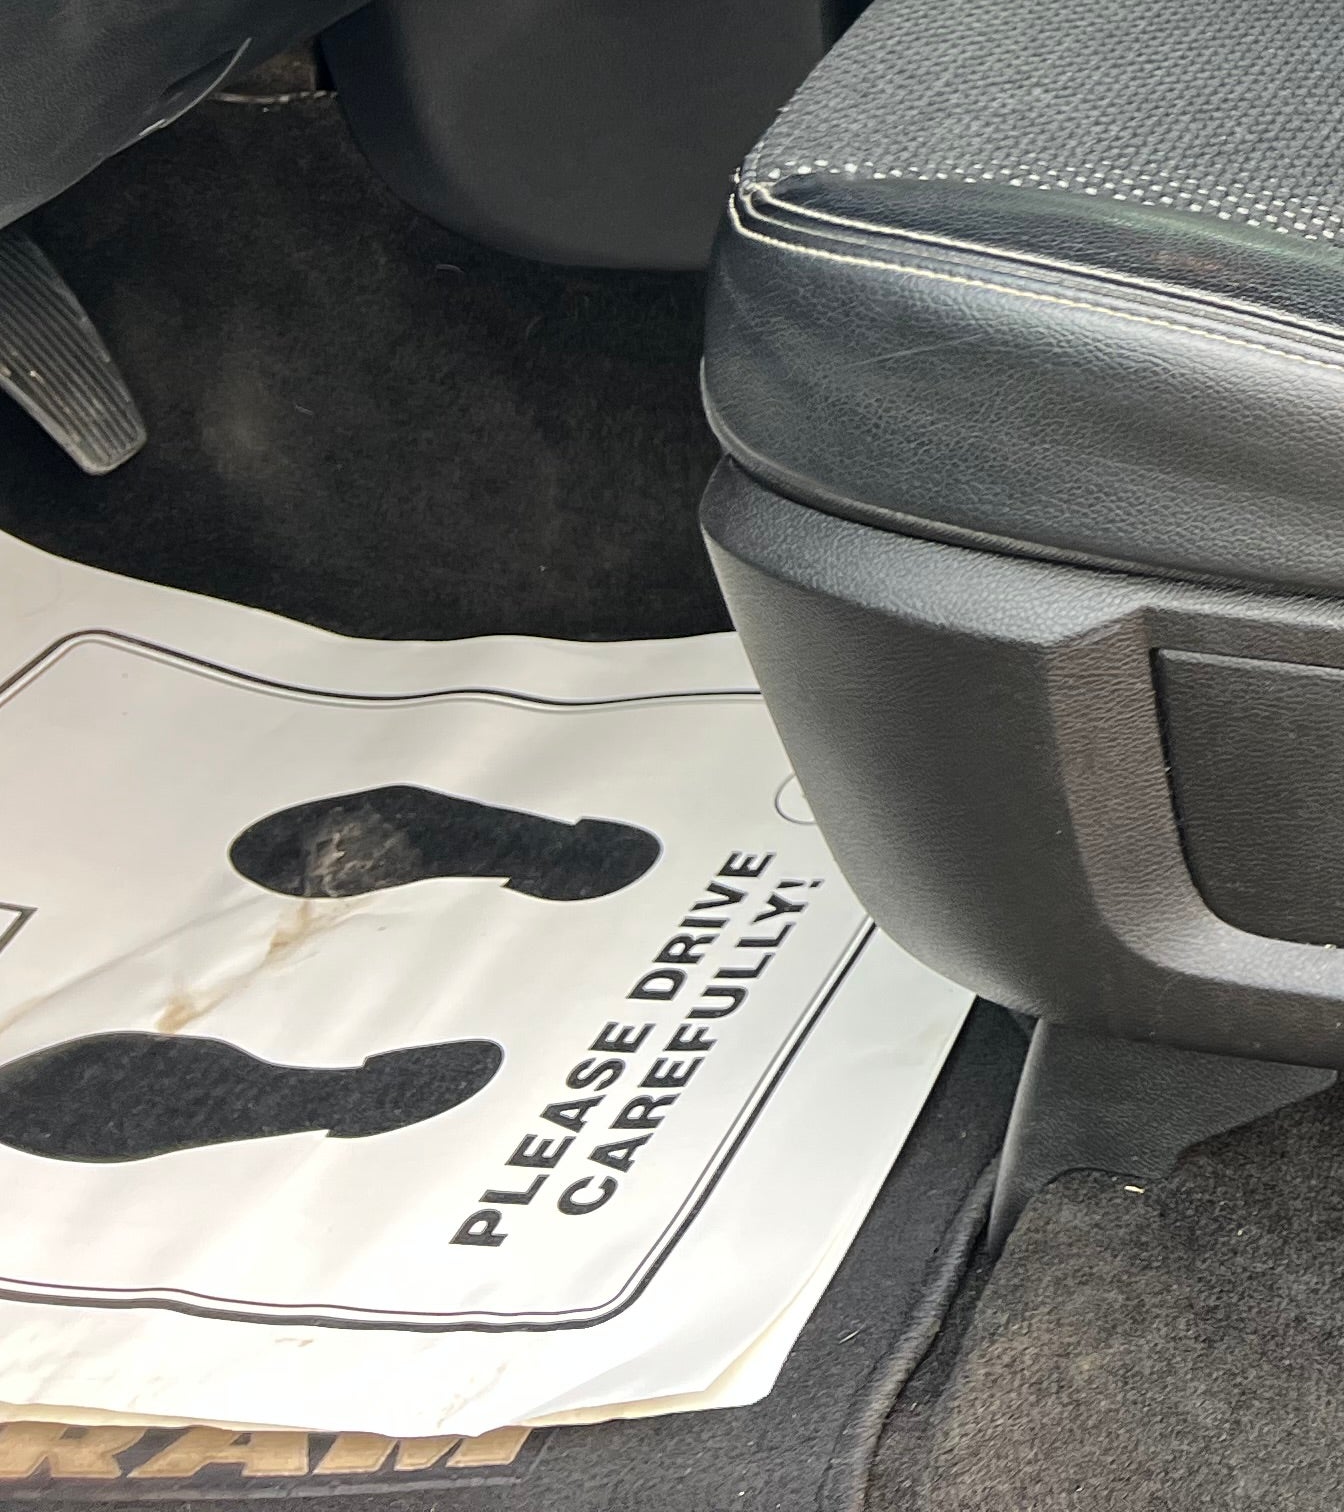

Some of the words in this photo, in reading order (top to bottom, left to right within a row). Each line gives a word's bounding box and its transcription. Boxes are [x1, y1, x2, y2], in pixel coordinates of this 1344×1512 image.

[449, 1021, 655, 1247] PLEASE
[626, 850, 776, 1001] DRIVE
[557, 878, 824, 1216] CAREFULLY!
